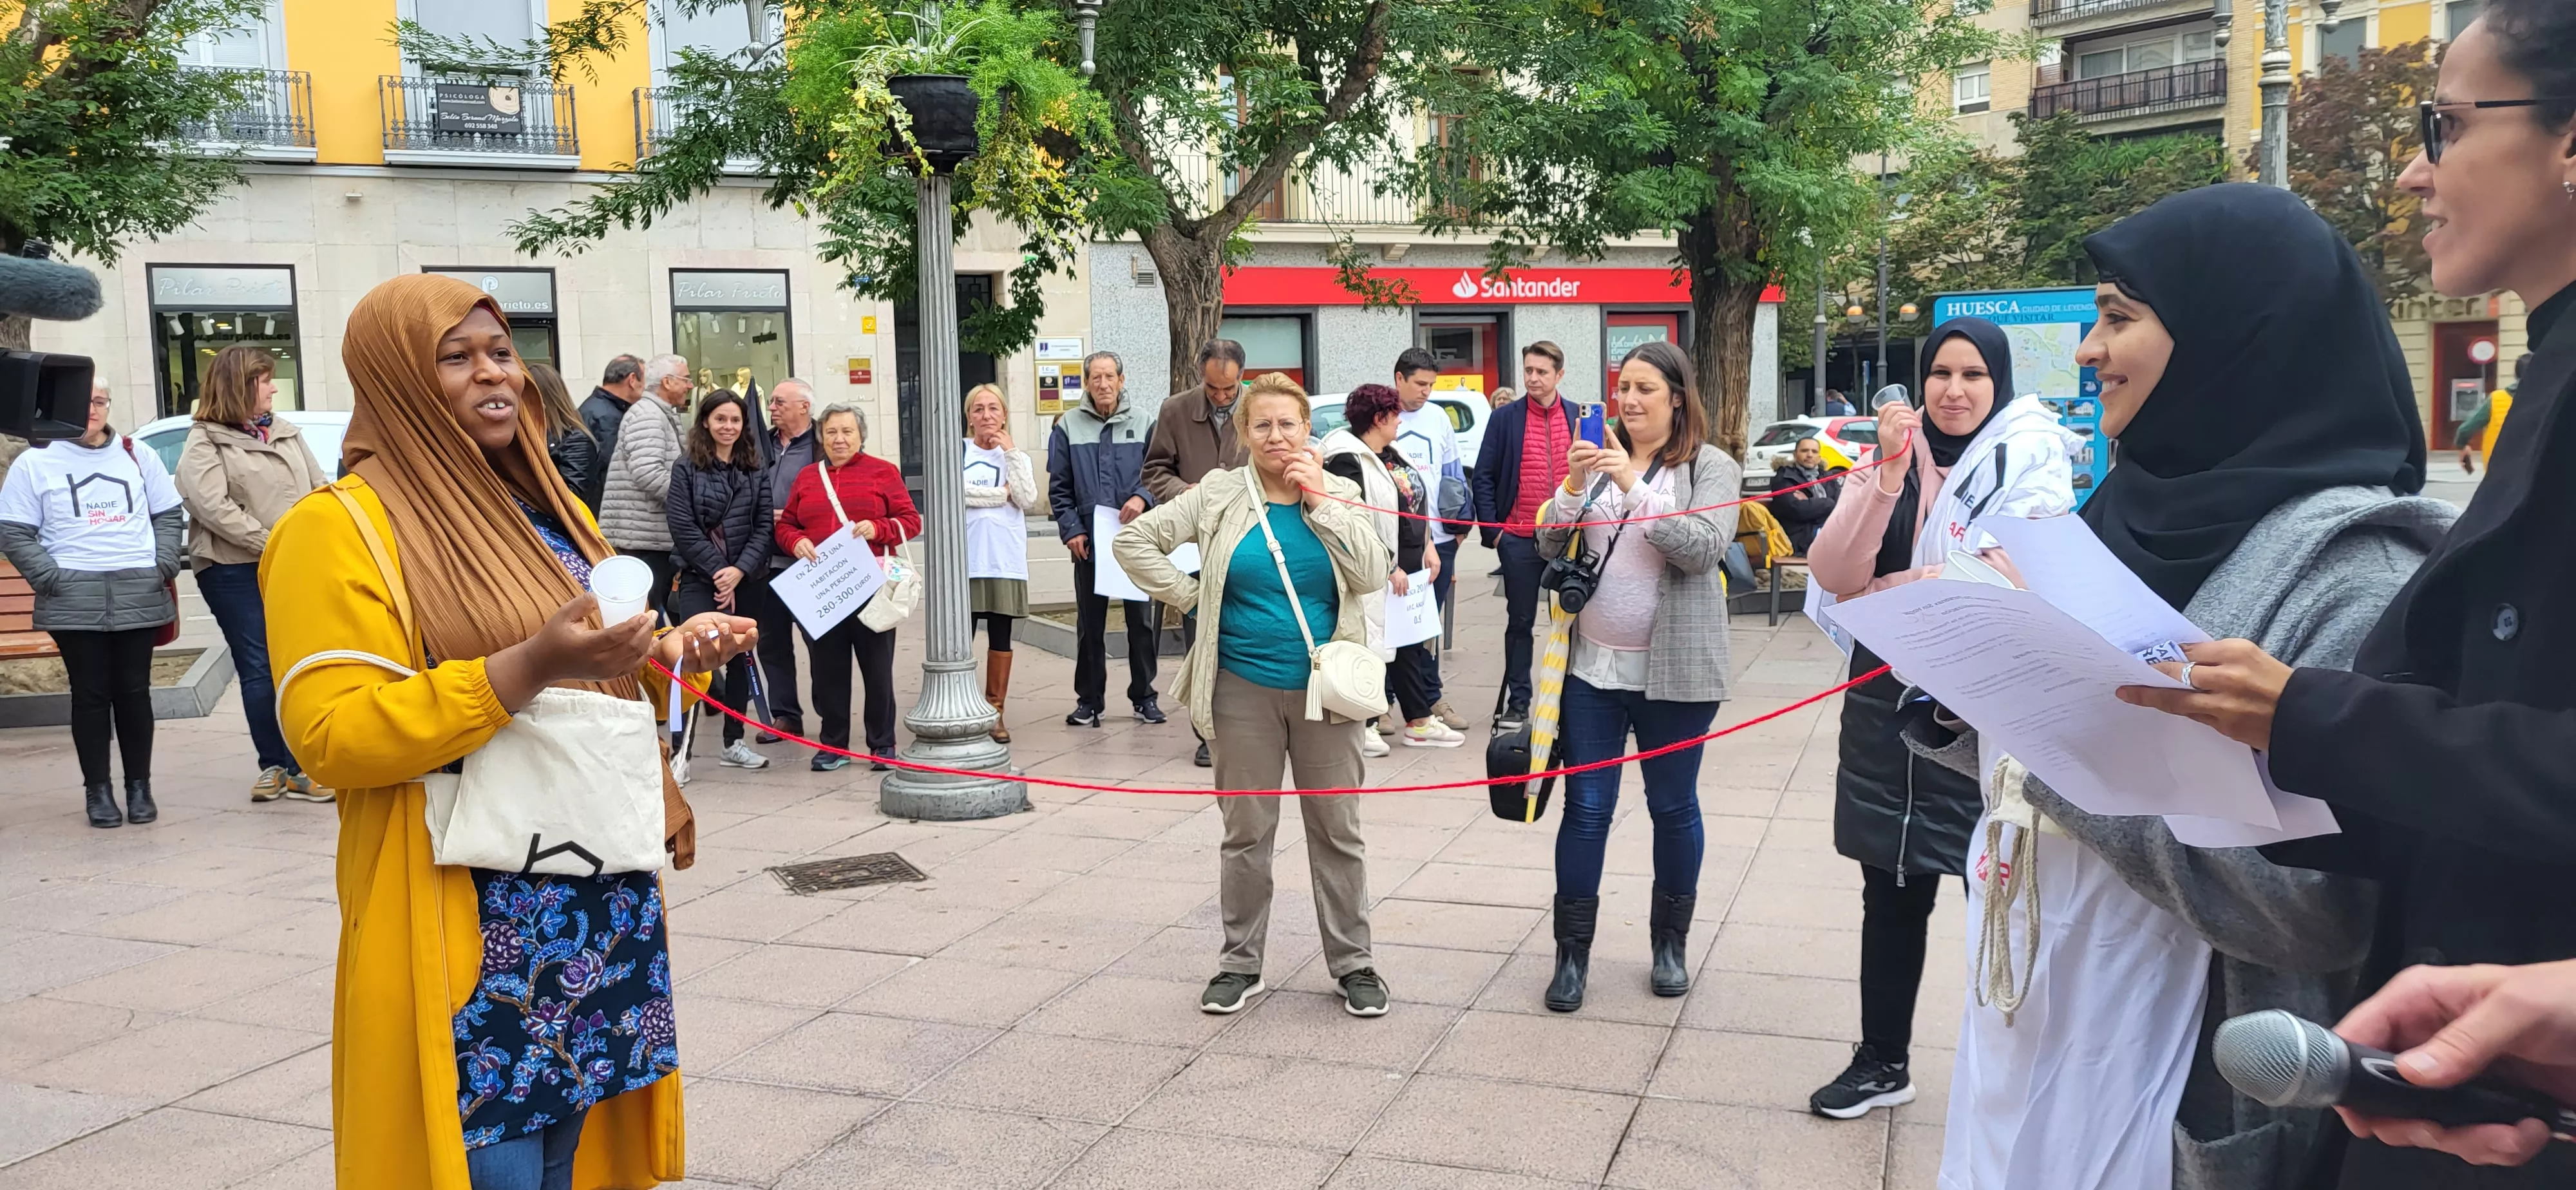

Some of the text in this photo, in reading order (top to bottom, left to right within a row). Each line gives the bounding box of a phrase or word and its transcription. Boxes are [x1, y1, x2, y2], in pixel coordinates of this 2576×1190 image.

[159, 277, 287, 296] Pilar Prieto
[678, 281, 782, 298] Pilar Prieto
[1481, 276, 1580, 298] Santander
[1947, 301, 2020, 316] HUESCA
[2013, 313, 2055, 322] VISITAR
[86, 500, 118, 509] NADIE
[90, 515, 126, 525] HOGAR
[795, 542, 844, 581] EN 2023 UNA
[815, 566, 858, 600] UNA PERSONA
[815, 572, 872, 619] 280-300 EUROS
